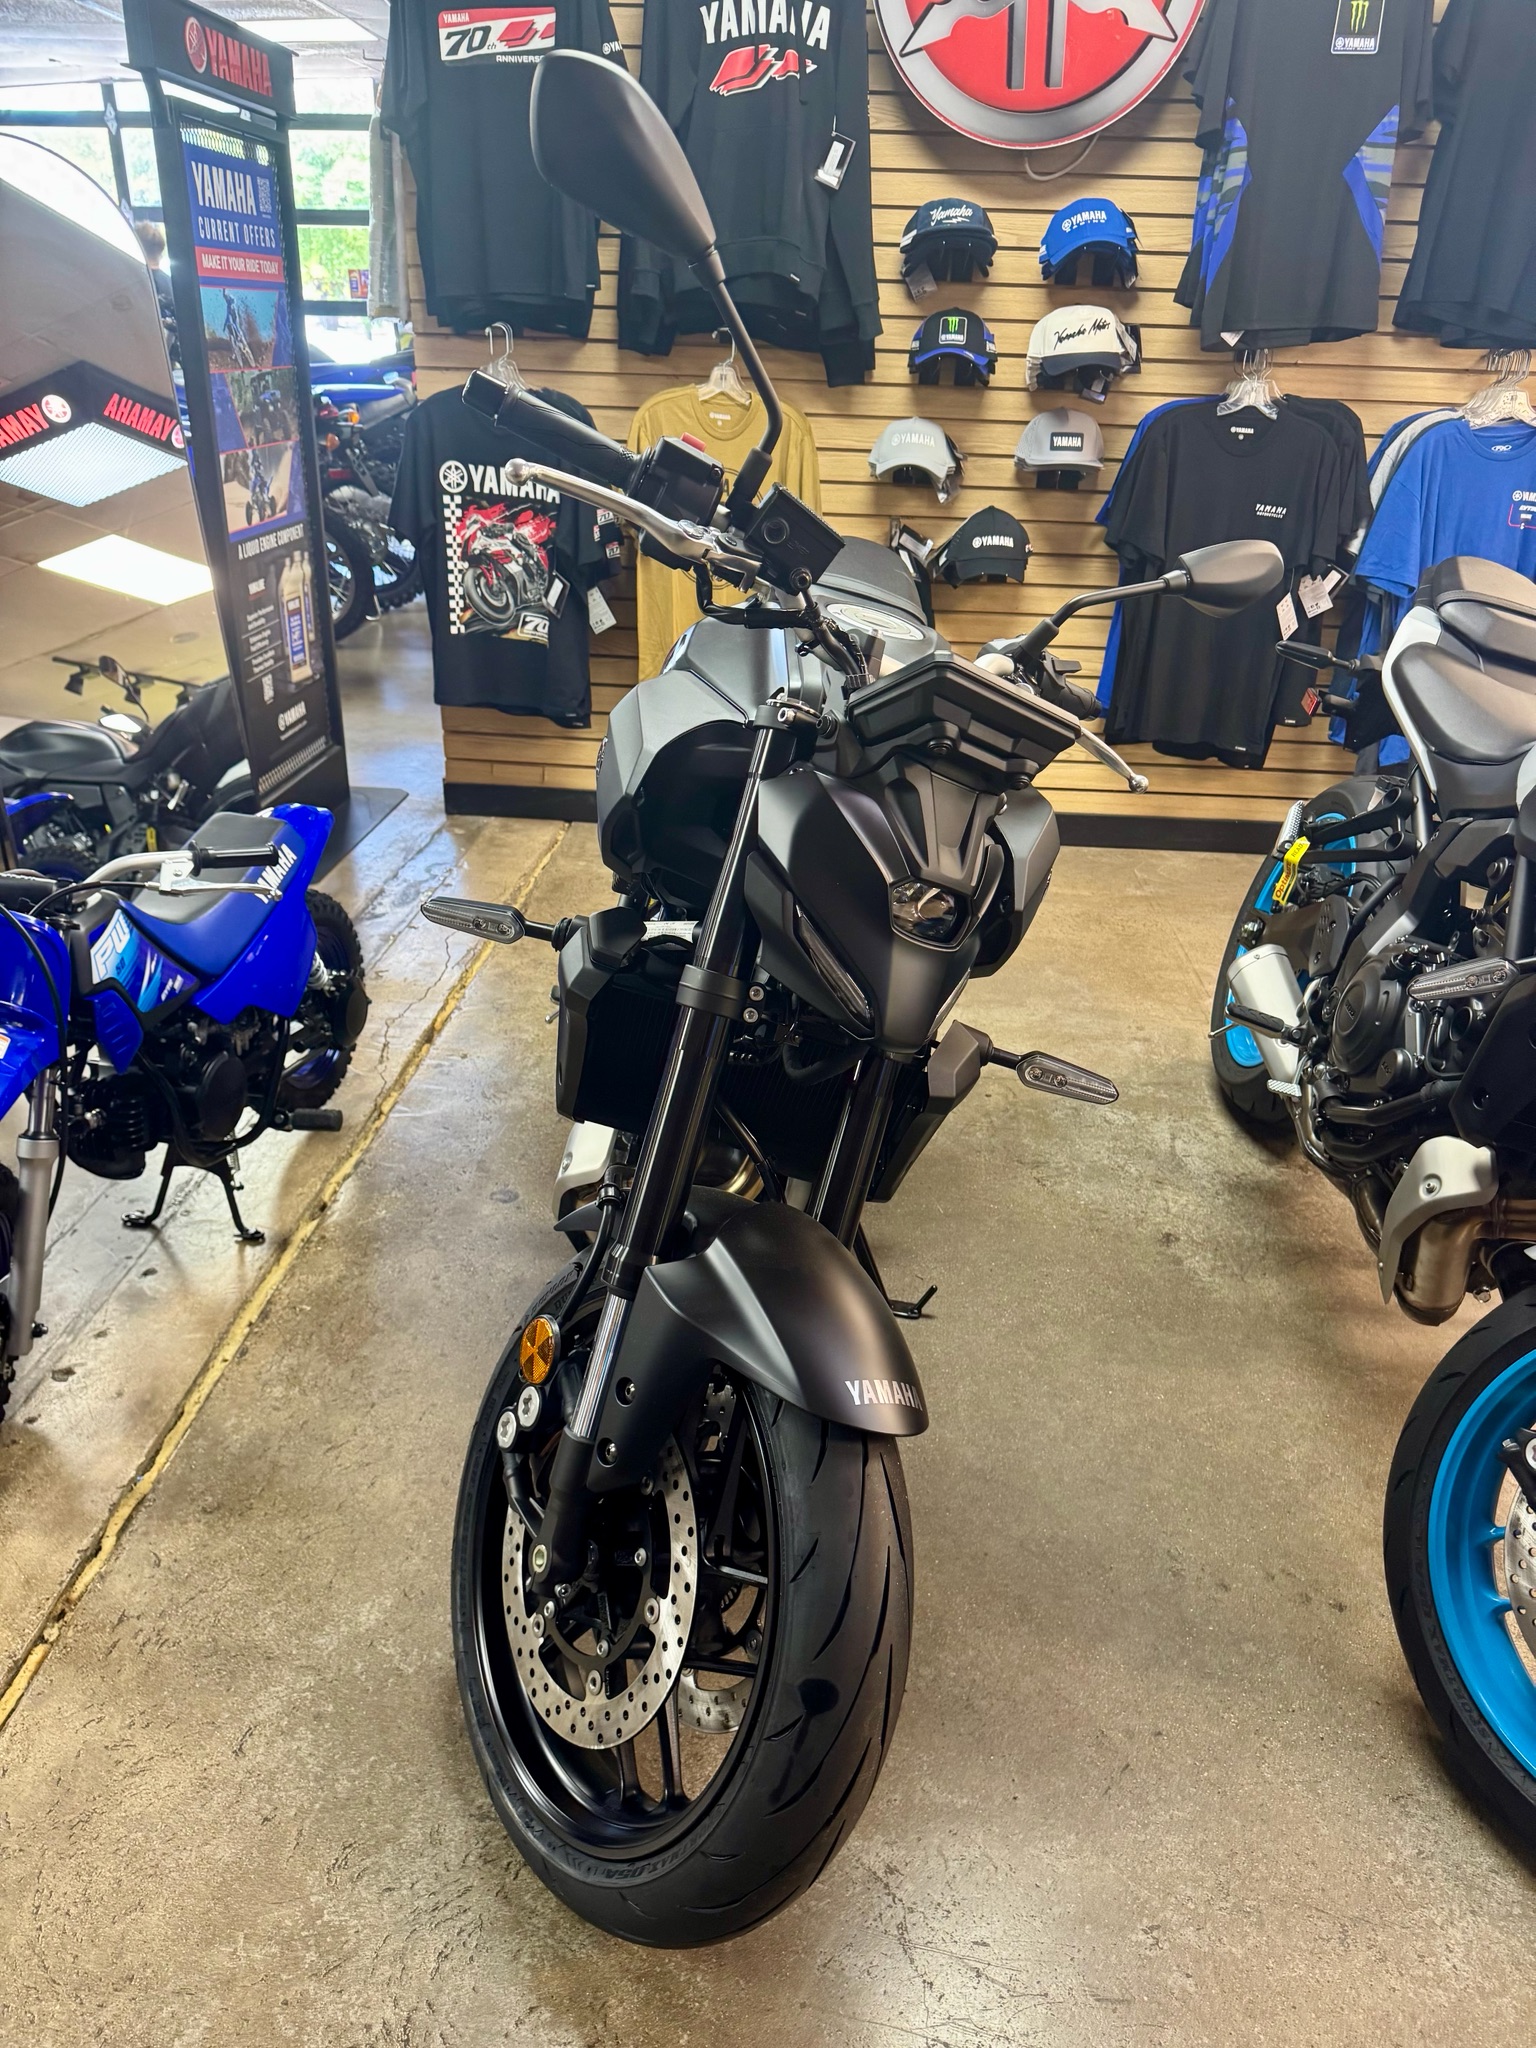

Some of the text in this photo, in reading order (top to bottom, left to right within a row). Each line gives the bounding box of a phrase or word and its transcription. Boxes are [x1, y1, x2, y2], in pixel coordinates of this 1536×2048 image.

[443, 12, 470, 24] YAMAHA
[1345, 37, 1375, 48] YAMAHA
[205, 26, 273, 97] YAMAHA
[496, 54, 544, 64] ANNIVERS
[191, 160, 257, 216] YAMAHA
[929, 205, 974, 226] Yamaha
[1071, 210, 1107, 227] YAMAHA
[198, 215, 276, 249] CURRENT OFFERS
[201, 253, 279, 275] MAKE IT YOUR RIDE TODAY
[900, 432, 936, 448] YAMAHA
[1052, 436, 1082, 448] YAMAHA
[1255, 503, 1287, 515] YAMAHA
[981, 535, 1014, 548] YAMAHA
[284, 700, 307, 727] YAMAHA
[844, 1379, 923, 1411] YAMAHA
